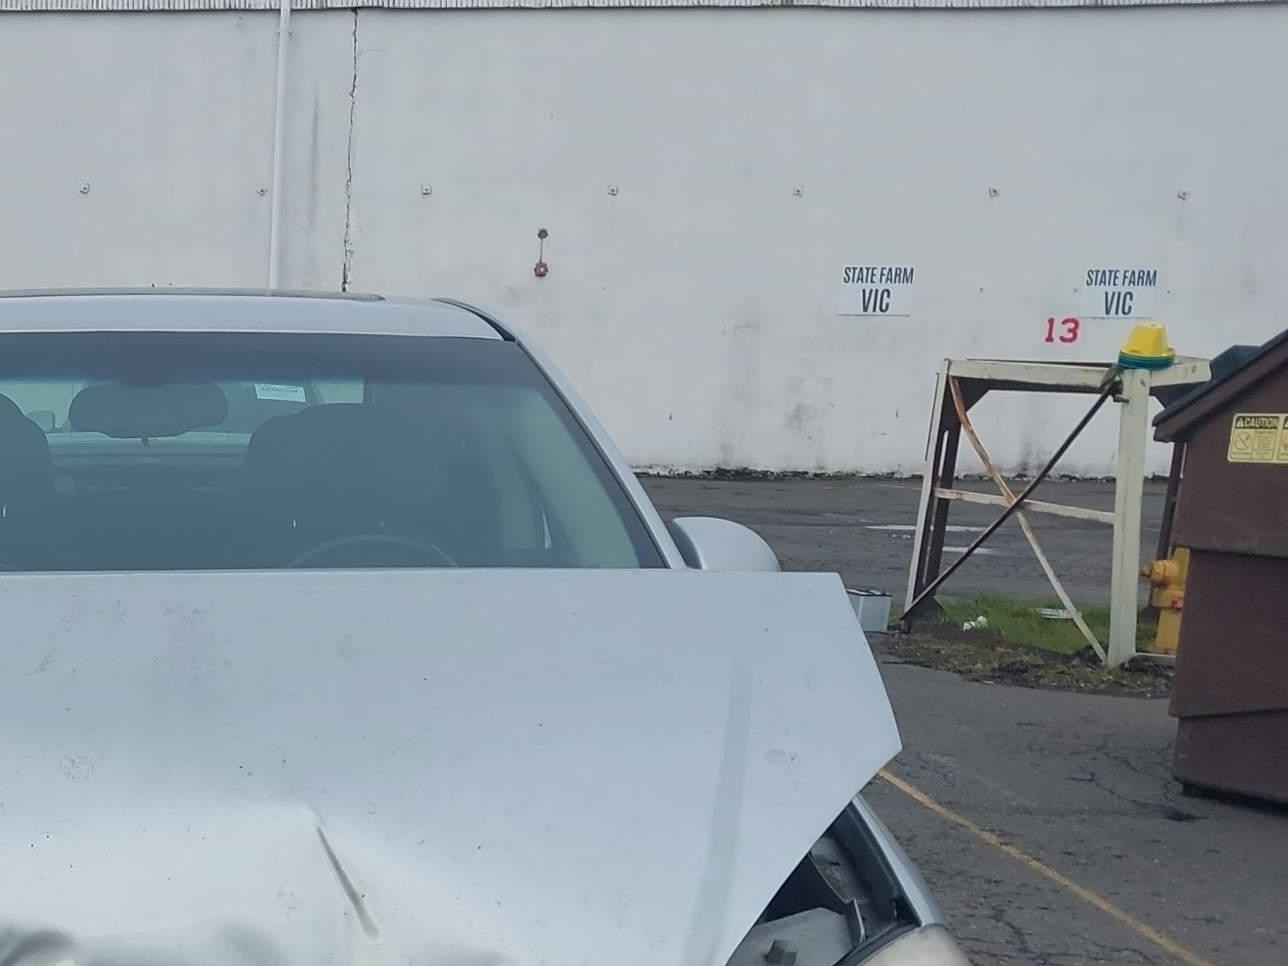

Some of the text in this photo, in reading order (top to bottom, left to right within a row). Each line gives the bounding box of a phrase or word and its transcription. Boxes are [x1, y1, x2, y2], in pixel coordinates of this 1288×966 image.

[843, 266, 914, 285] STATE FARM
[1086, 269, 1158, 287] STATE FARM
[861, 288, 891, 313] VIC
[1104, 291, 1134, 316] VIC
[1044, 317, 1080, 343] 13
[1244, 417, 1278, 428] CAUTION
